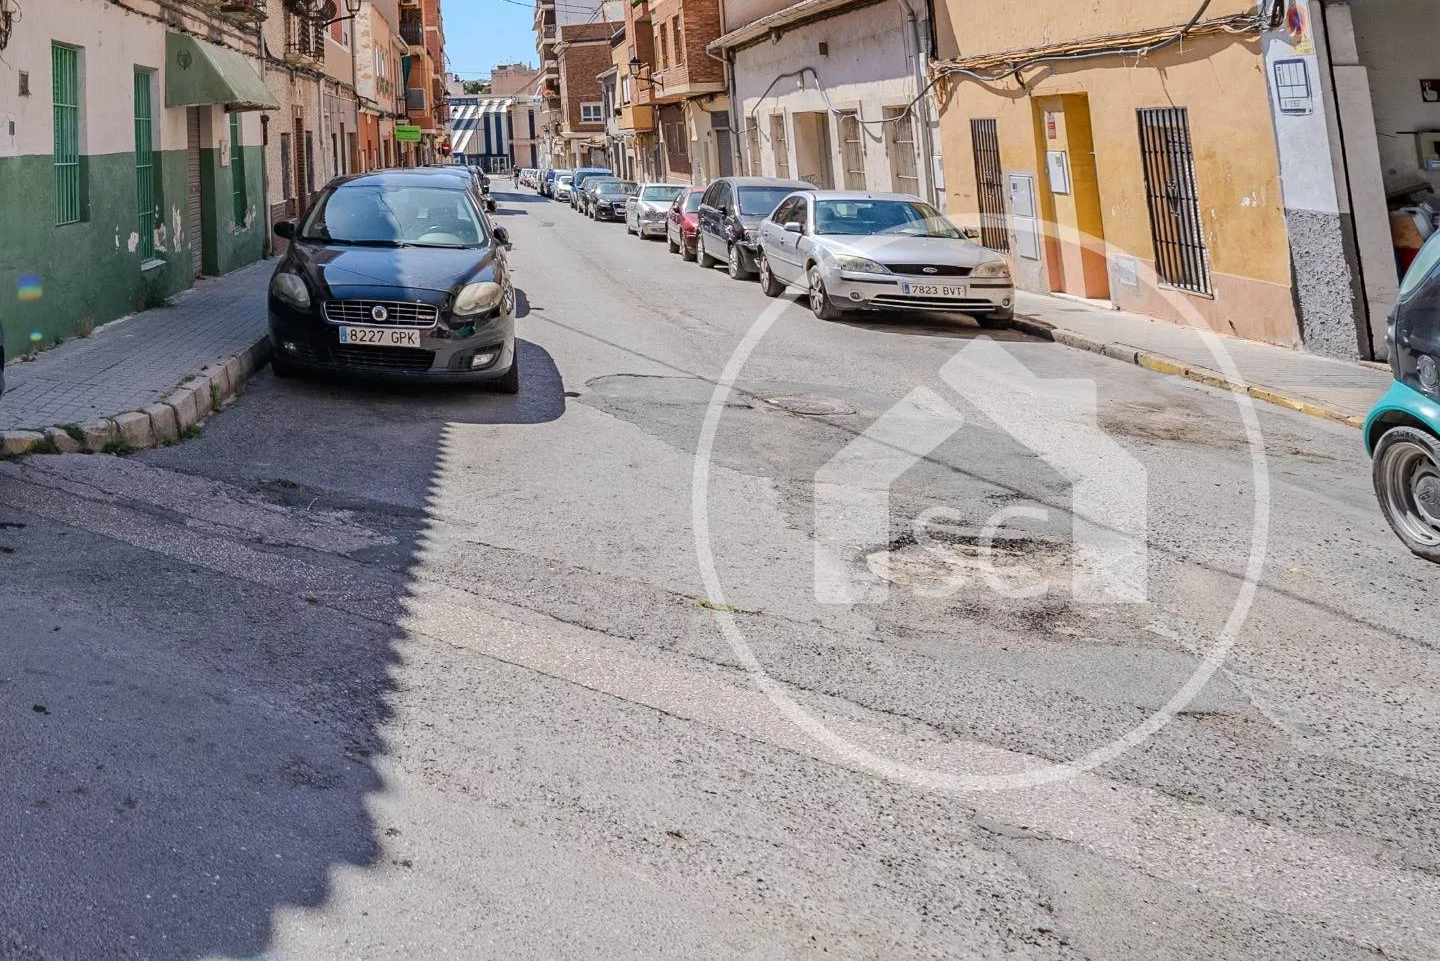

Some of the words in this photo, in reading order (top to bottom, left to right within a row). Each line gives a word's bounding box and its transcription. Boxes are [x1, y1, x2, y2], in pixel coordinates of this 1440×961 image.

[912, 285, 938, 295] 7823
[942, 286, 962, 296] BVT
[350, 328, 384, 342] 8227
[391, 331, 416, 345] GPK
